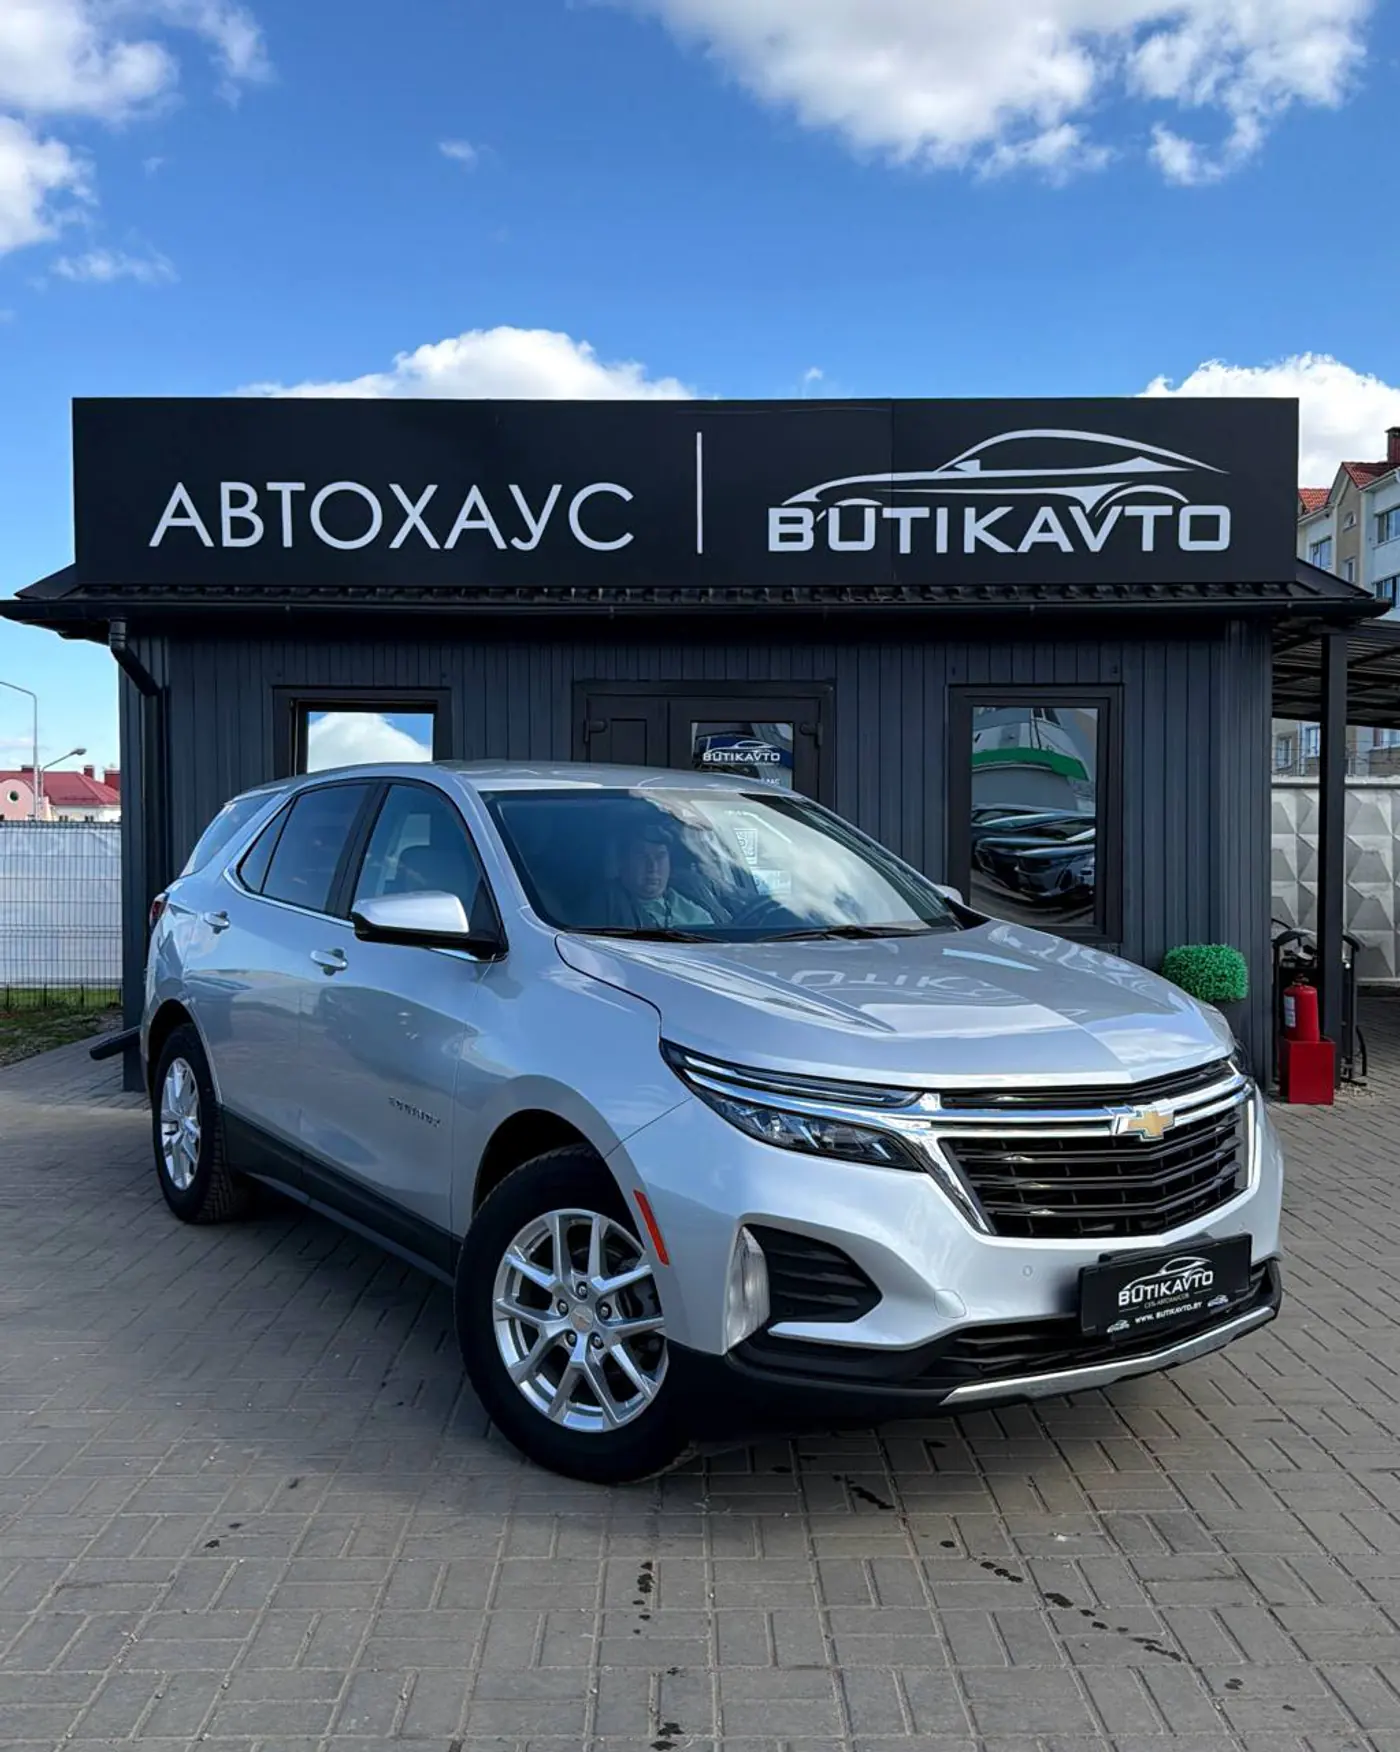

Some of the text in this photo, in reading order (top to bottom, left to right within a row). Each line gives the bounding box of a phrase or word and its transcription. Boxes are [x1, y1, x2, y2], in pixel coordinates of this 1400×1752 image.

[149, 481, 634, 552] АВТОХАУС
[767, 503, 1232, 555] BUTIKAVTO
[702, 752, 781, 762] BUTIKAVTO
[1118, 1270, 1213, 1306] BUTIKAVTO
